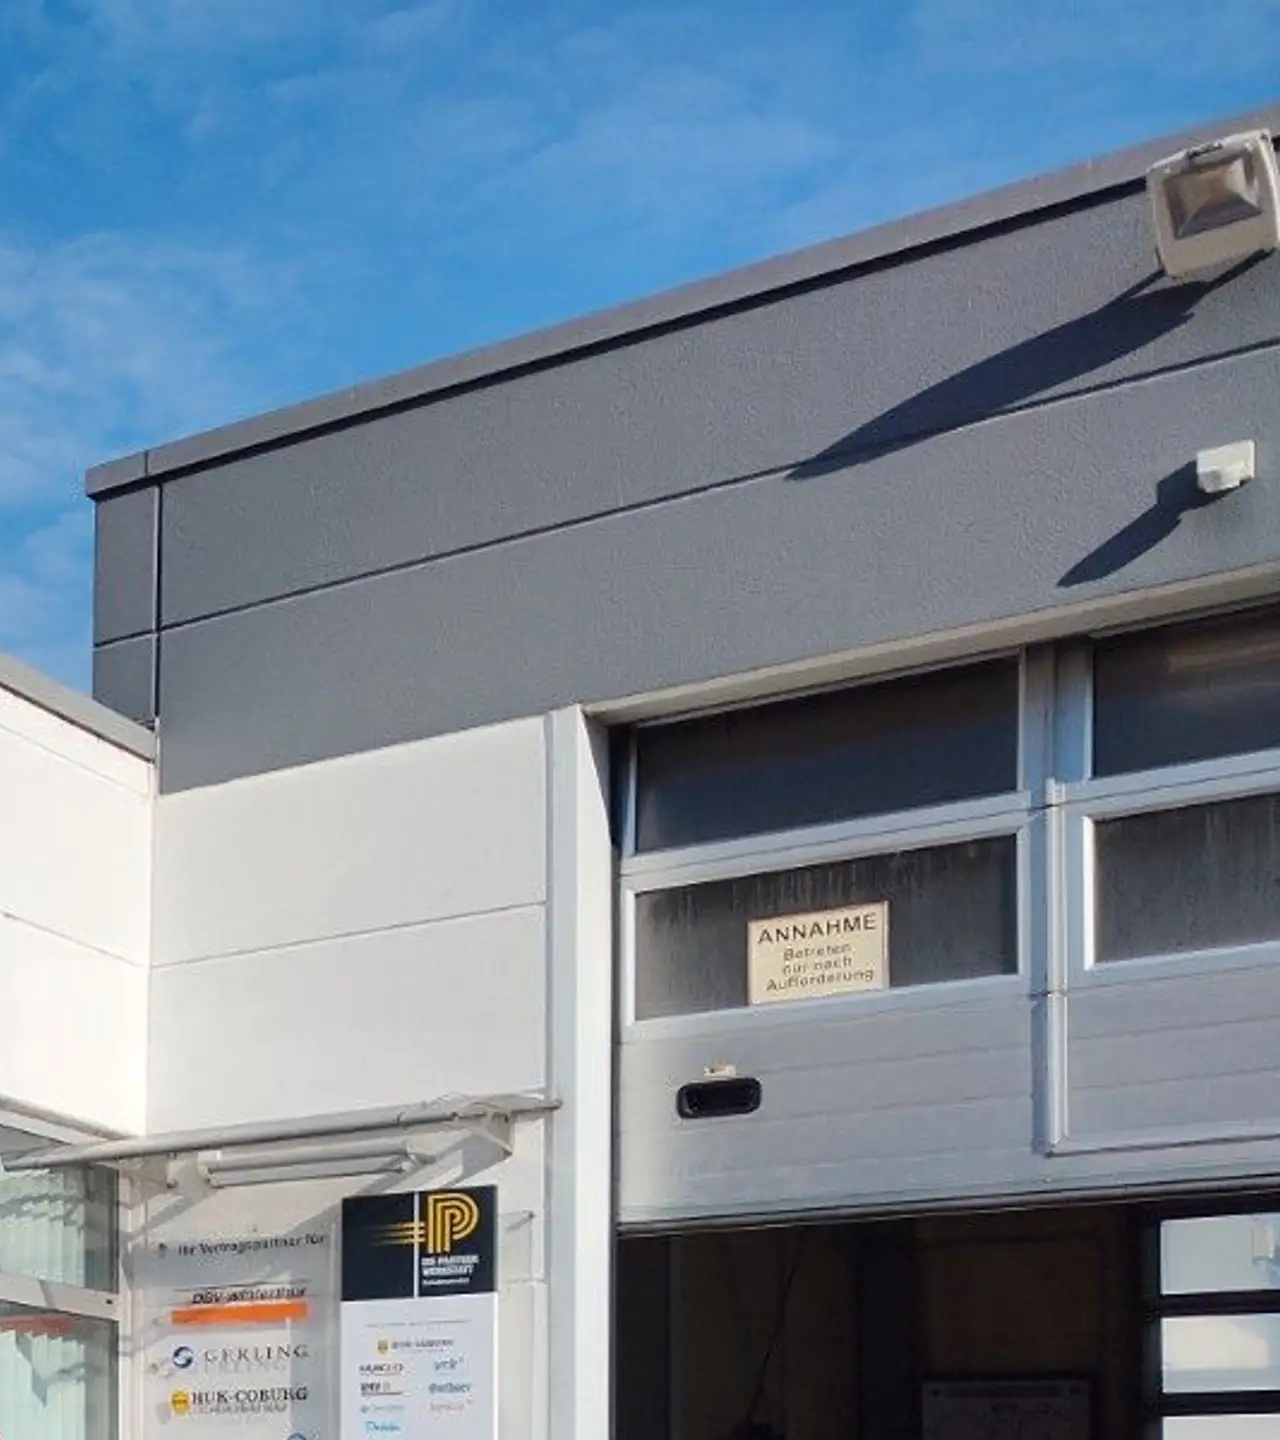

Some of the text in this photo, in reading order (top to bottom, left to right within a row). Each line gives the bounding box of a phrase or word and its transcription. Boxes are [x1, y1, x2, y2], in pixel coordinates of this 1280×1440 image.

[757, 911, 877, 945] ANNAHME
[782, 955, 852, 976] nur nach
[204, 1344, 309, 1362] GERLING
[192, 1385, 309, 1405] HUK-COBURG
